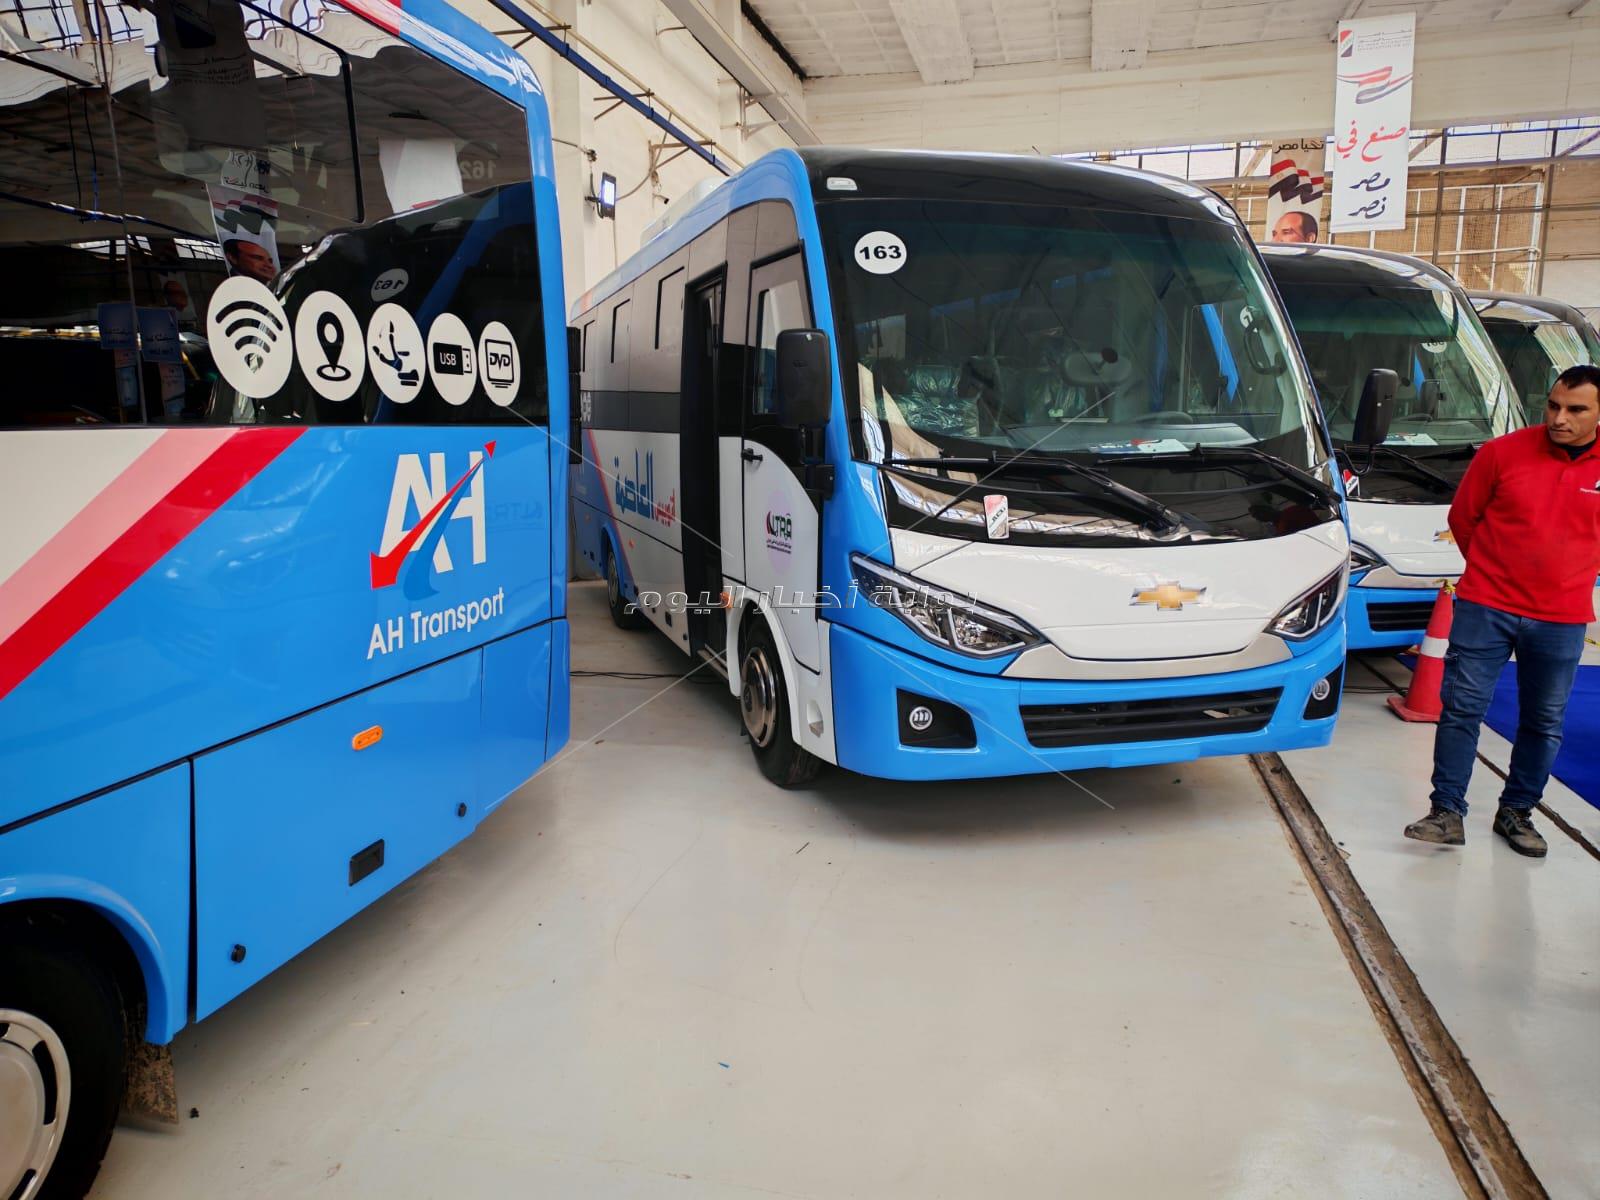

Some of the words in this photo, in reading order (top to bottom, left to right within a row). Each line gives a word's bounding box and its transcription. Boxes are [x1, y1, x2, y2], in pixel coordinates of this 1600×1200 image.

[1274, 143, 1299, 154] مصر
[1301, 138, 1325, 153] تحيا
[1336, 119, 1358, 159] في
[1361, 126, 1407, 162] صنع
[1348, 172, 1391, 192] مصر
[1347, 196, 1387, 219] نصر
[859, 245, 902, 260] 163
[439, 352, 457, 366] USB
[489, 352, 511, 371] DVD
[613, 447, 654, 520] العاصمة
[378, 451, 487, 573] AH
[367, 616, 404, 660] AH
[411, 587, 504, 644] Transport
